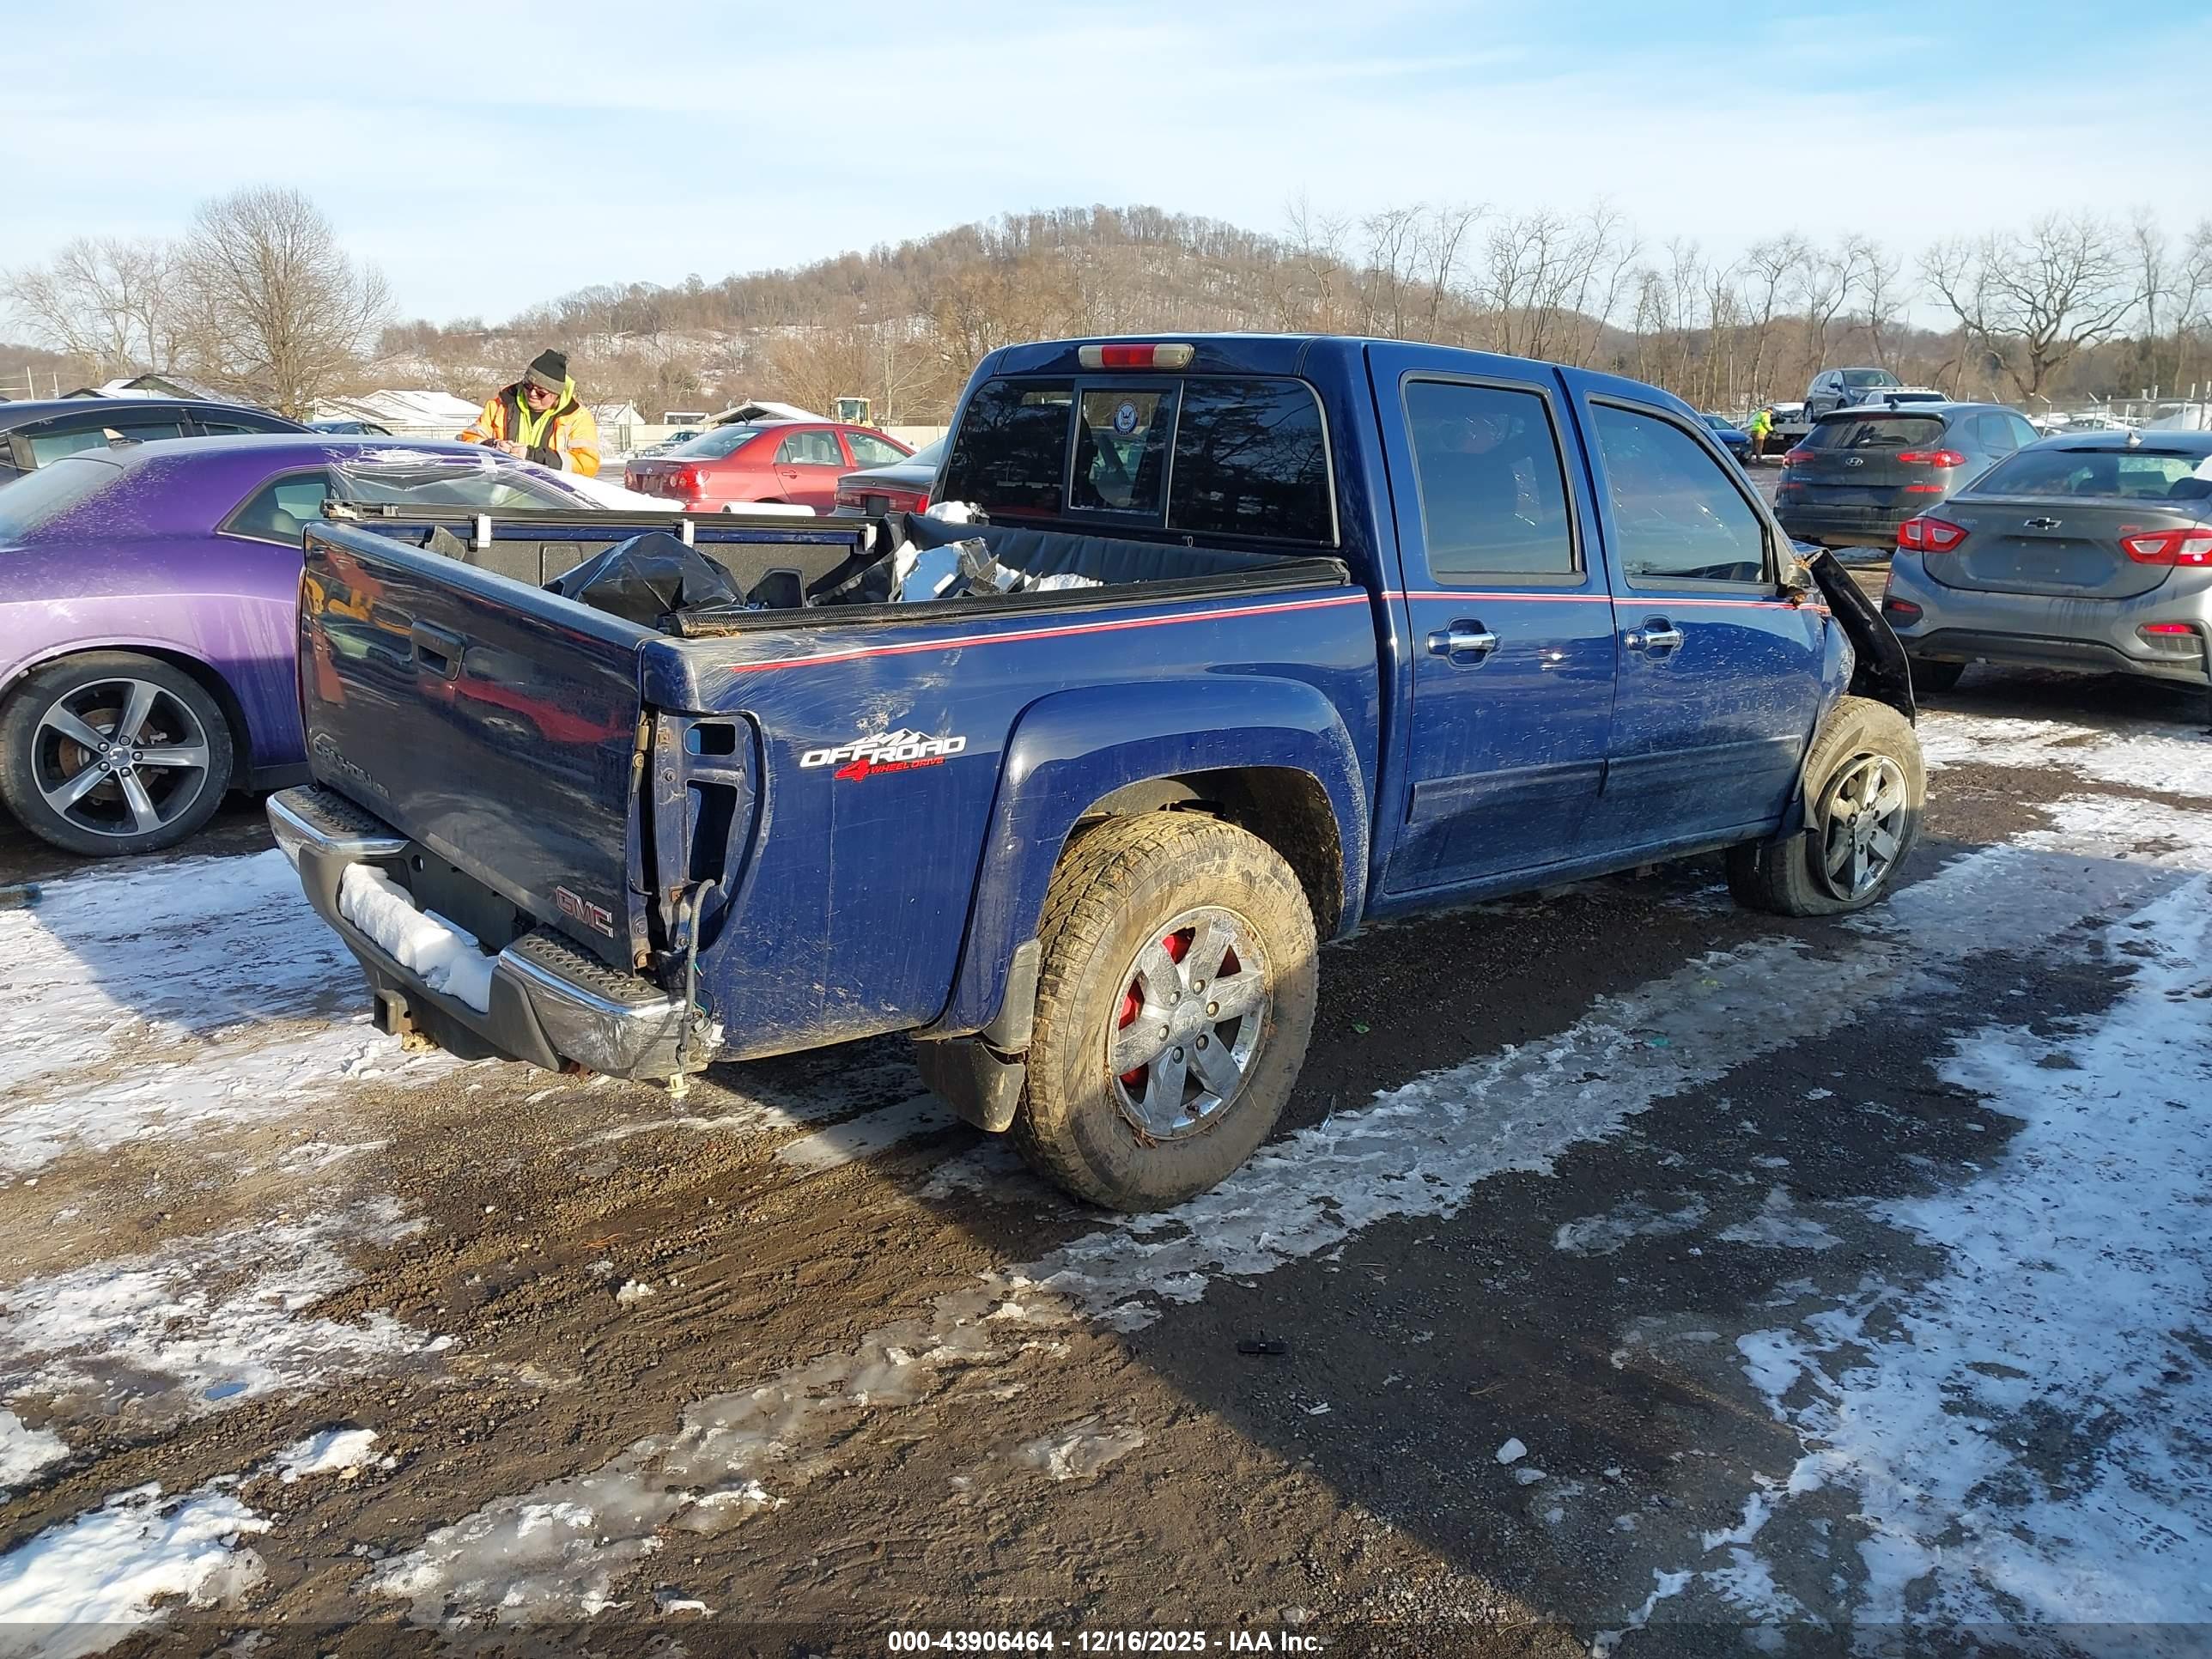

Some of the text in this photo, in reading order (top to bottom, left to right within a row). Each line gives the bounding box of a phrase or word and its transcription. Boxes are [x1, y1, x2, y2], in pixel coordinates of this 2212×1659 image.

[833, 756, 945, 782] 4 WHEEL DRIVE
[556, 885, 613, 939] GMC
